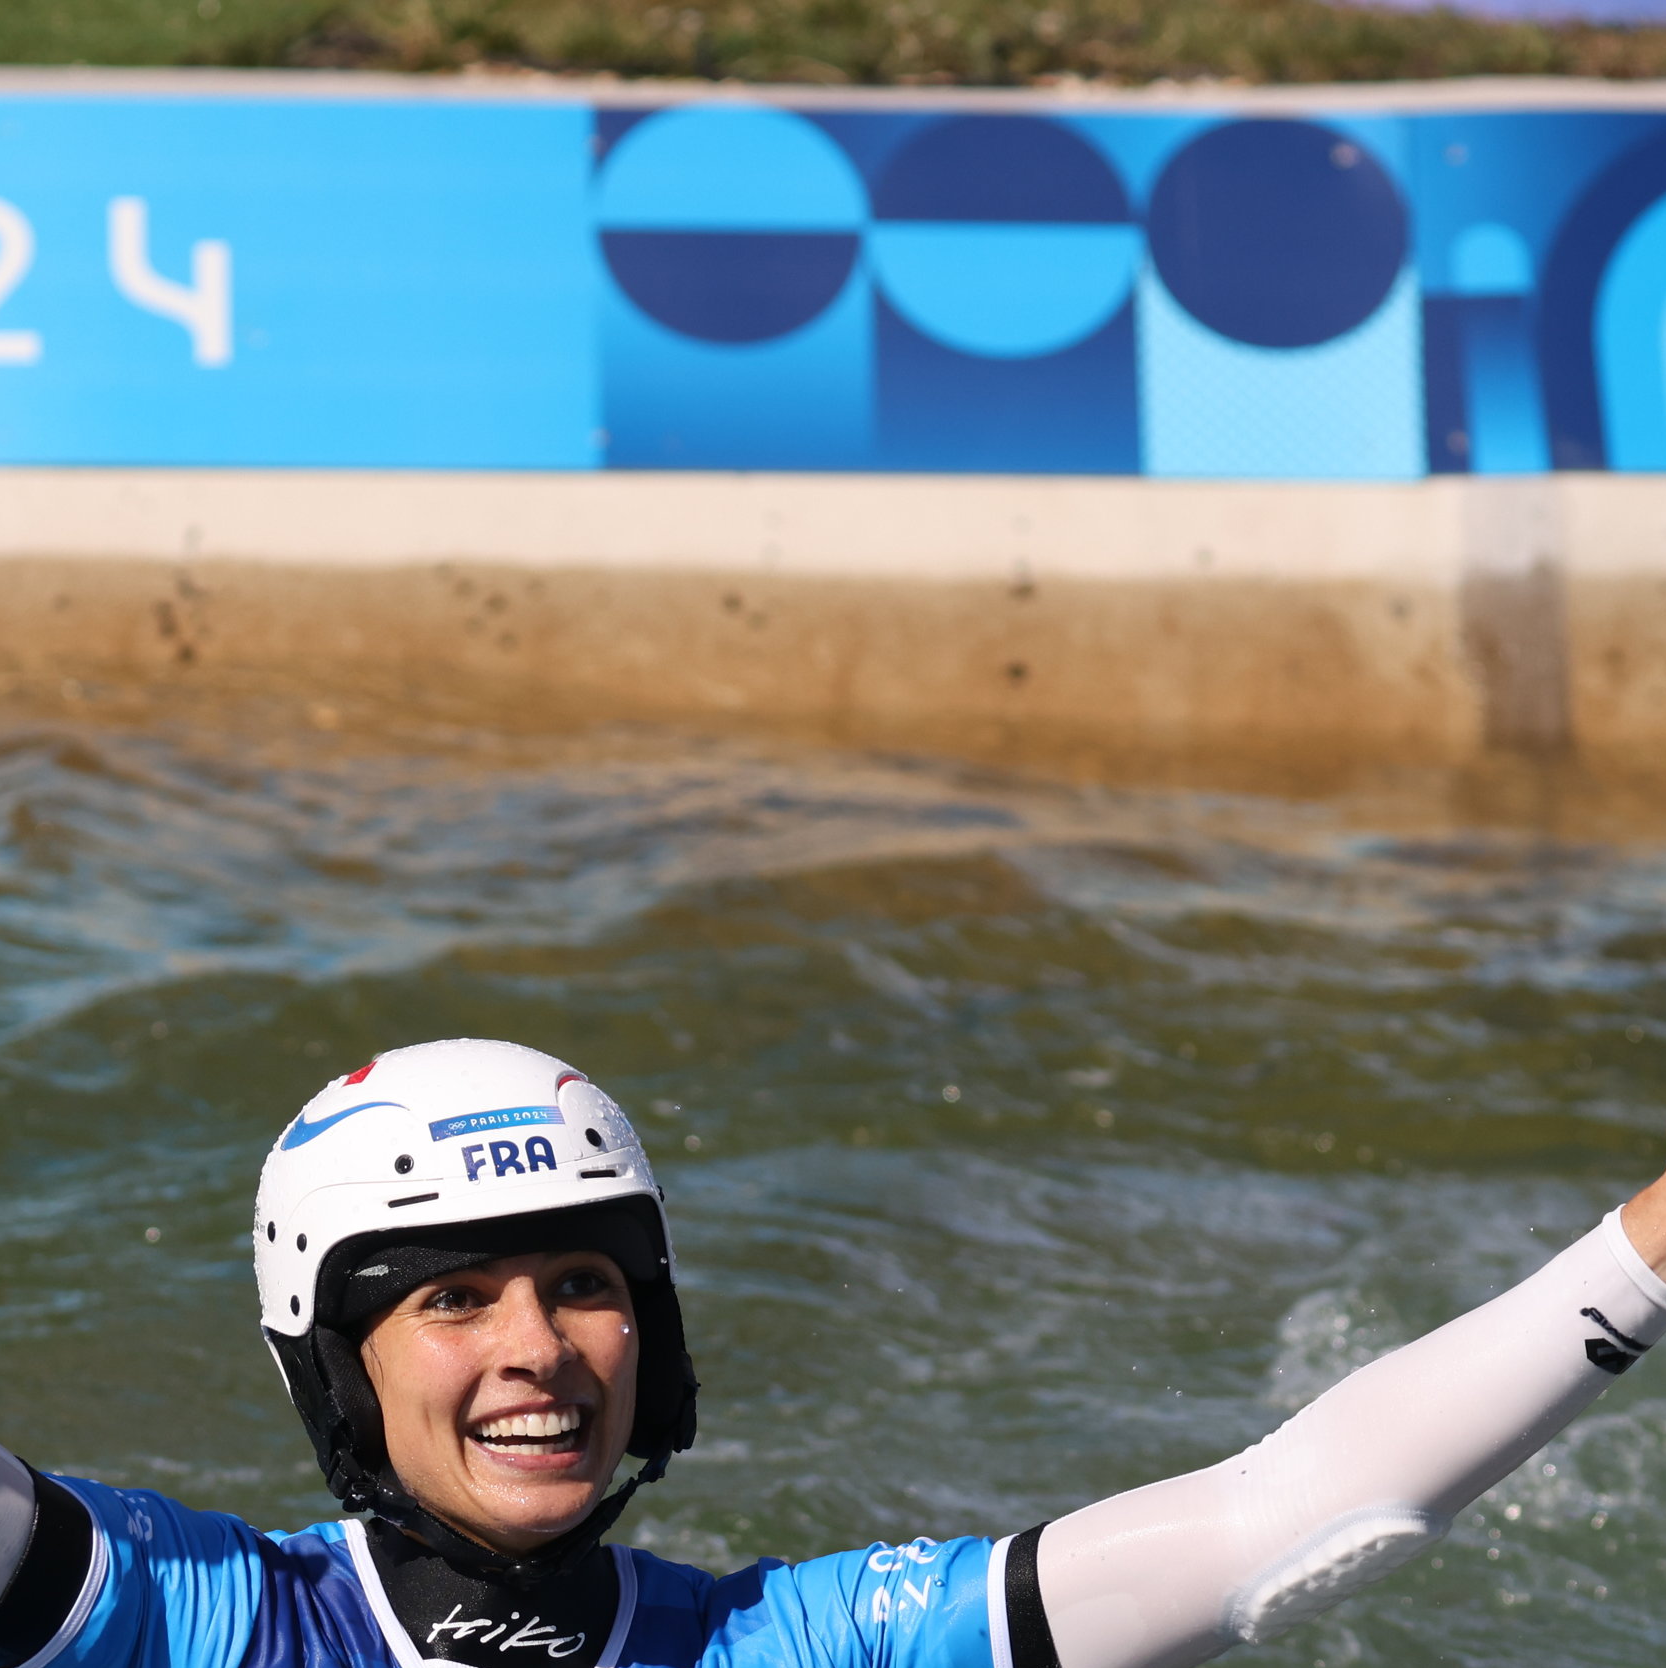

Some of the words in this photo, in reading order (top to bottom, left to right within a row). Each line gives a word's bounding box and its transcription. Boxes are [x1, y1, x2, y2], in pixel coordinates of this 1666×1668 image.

[470, 1113, 510, 1127] PARIS
[513, 1111, 549, 1121] 2024
[461, 1135, 558, 1182] FRA
